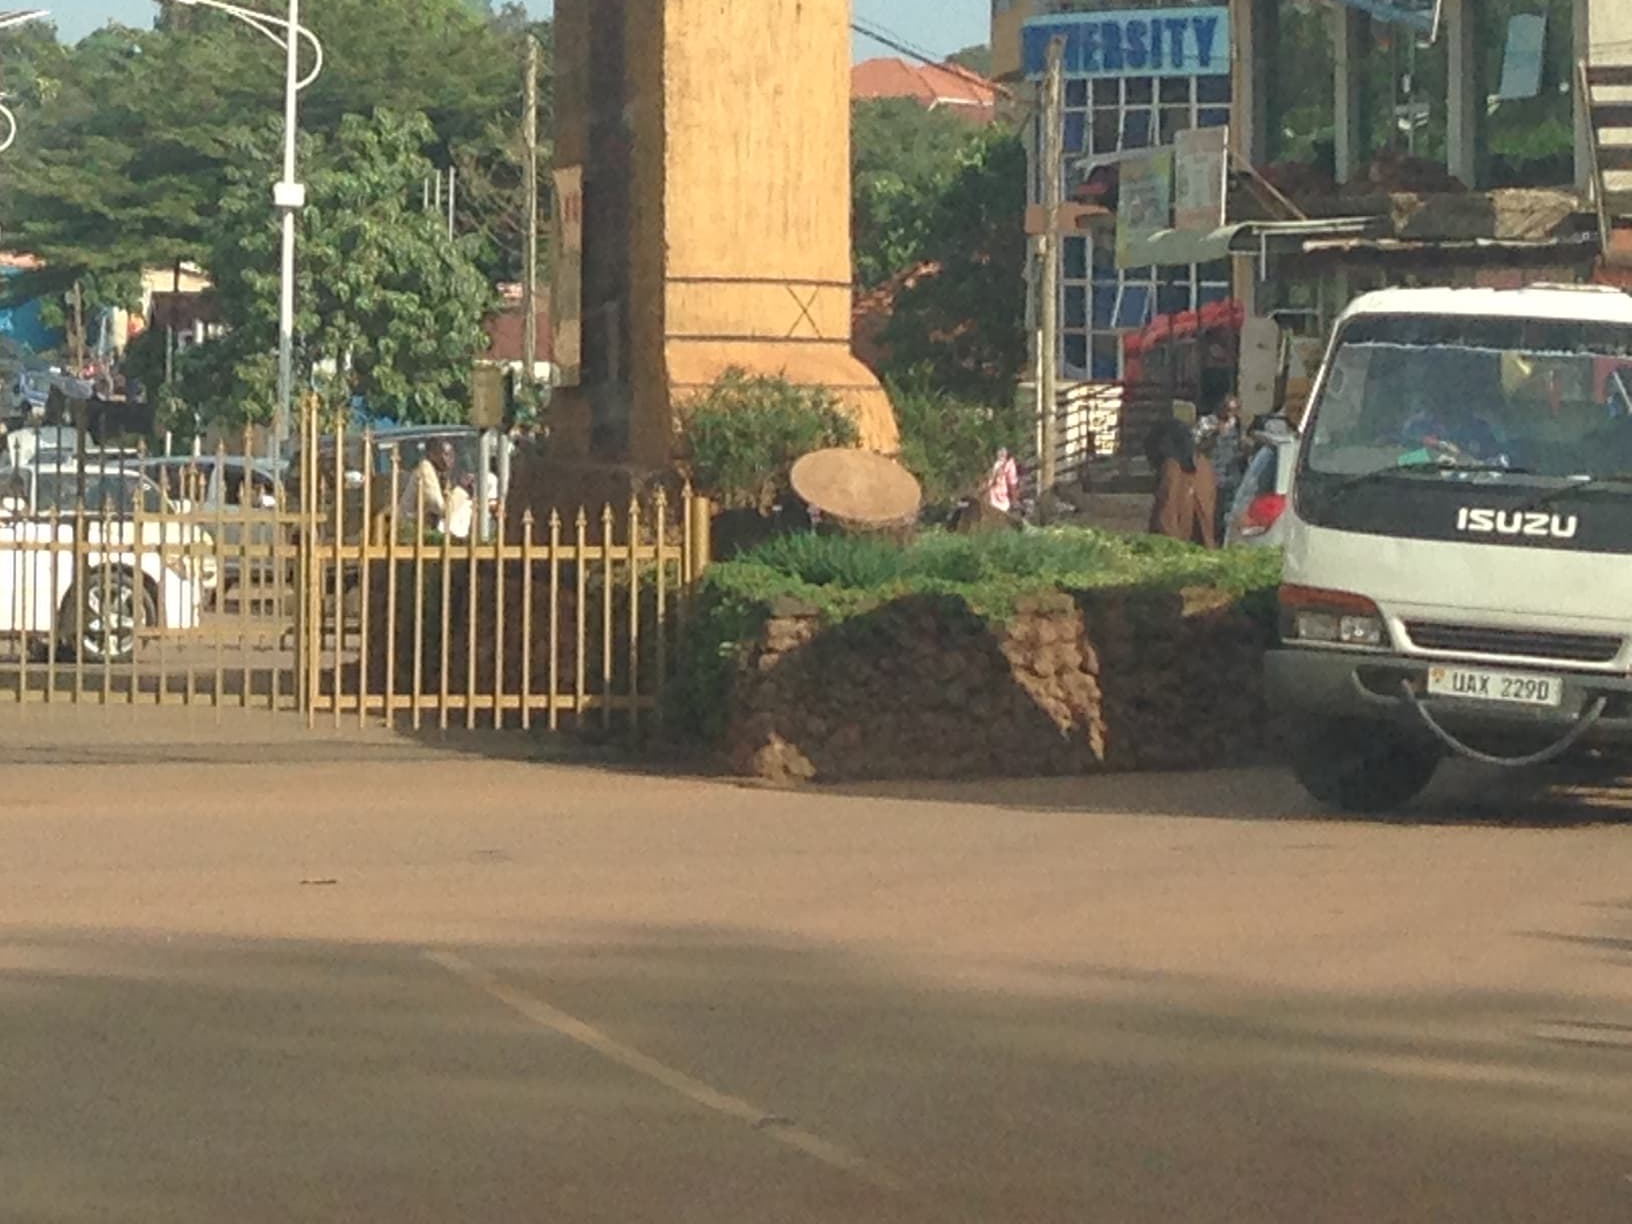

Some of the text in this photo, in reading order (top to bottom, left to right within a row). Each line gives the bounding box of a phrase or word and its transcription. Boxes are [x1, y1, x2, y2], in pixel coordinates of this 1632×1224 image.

[1023, 16, 1218, 73] ERSITY
[1456, 507, 1578, 538] ISUZU
[1452, 671, 1550, 701] UAX 229D
